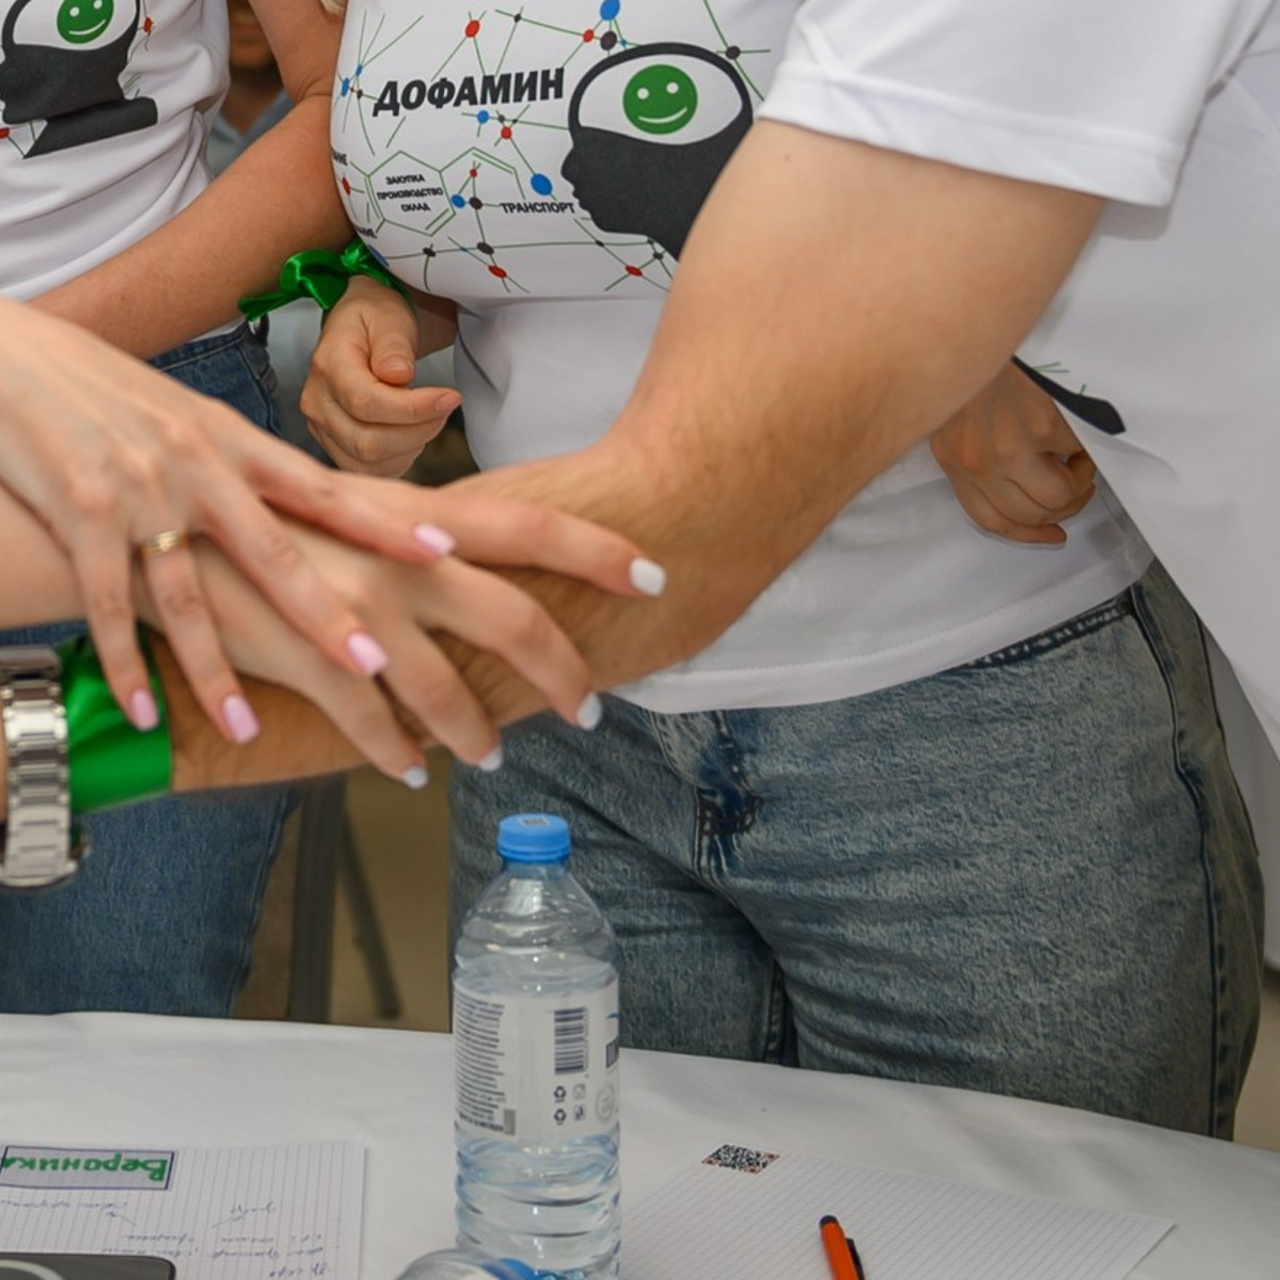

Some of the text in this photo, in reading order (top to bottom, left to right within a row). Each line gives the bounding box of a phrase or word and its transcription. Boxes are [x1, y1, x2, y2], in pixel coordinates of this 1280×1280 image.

[372, 67, 565, 117] ДОФАМИН
[376, 187, 444, 200] ПРОИЗВОДСТВО
[401, 202, 431, 212] СКЛАД
[500, 201, 576, 215] ТРАНСПОРТ
